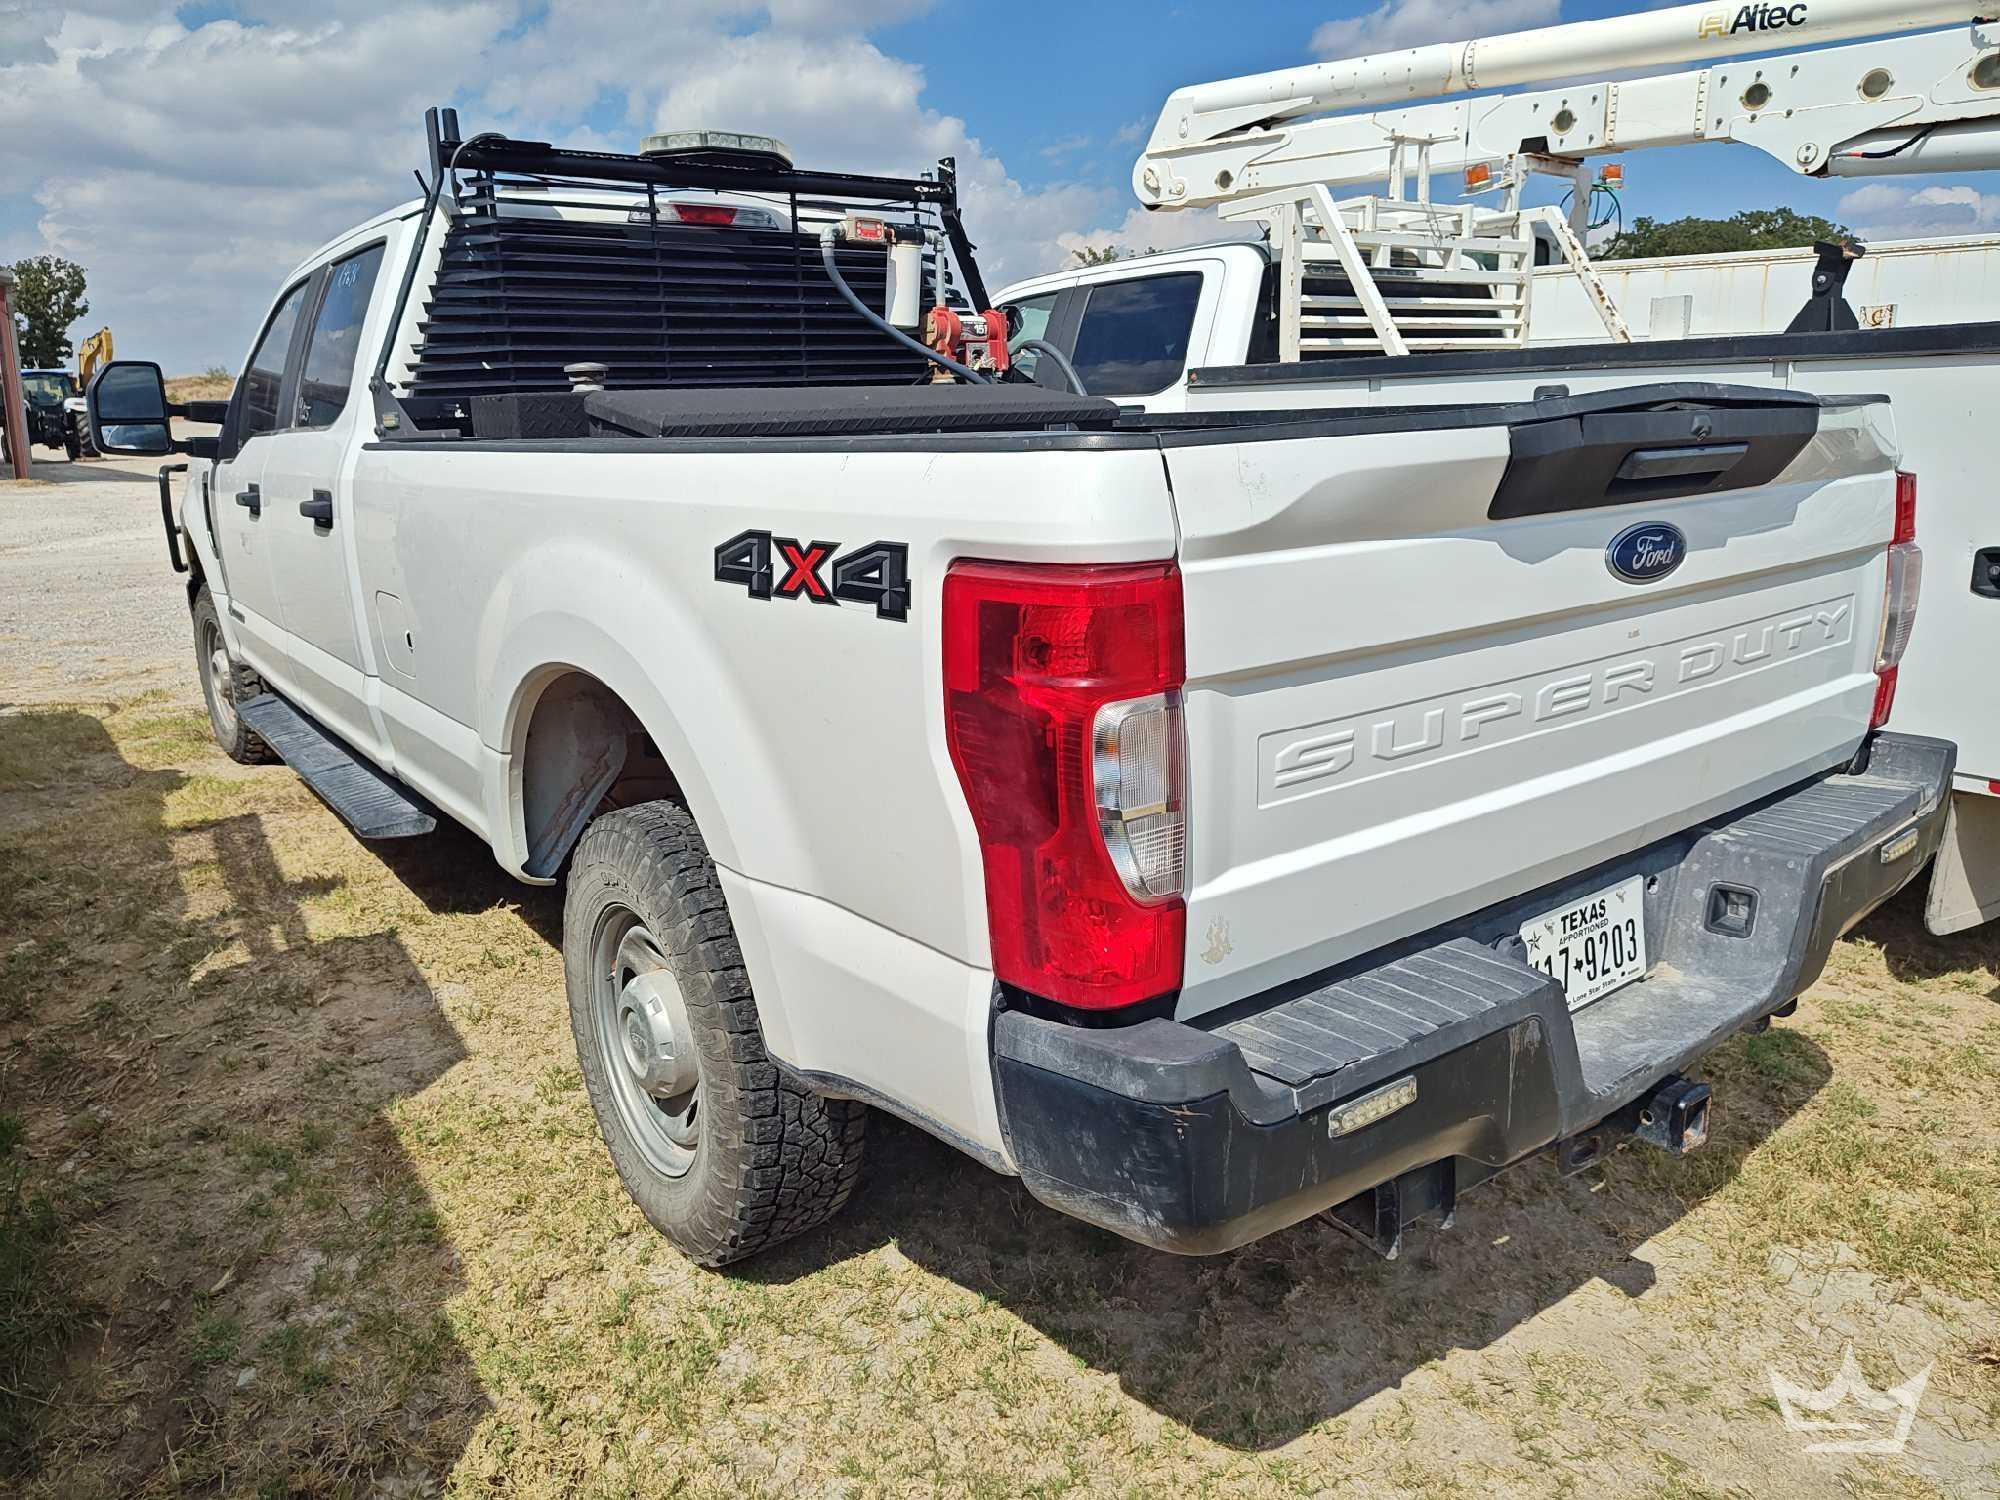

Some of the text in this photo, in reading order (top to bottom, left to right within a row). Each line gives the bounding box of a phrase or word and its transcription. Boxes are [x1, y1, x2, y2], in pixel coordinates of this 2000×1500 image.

[1730, 3, 1808, 34] Altec
[1632, 534, 1675, 570] Ford
[1274, 602, 1849, 789] SUPER DUTY
[1558, 918, 1609, 946] APPORTIONED
[1560, 898, 1606, 935] TEXAS
[1584, 917, 1638, 982] 9203
[1588, 984, 1601, 996] Star
